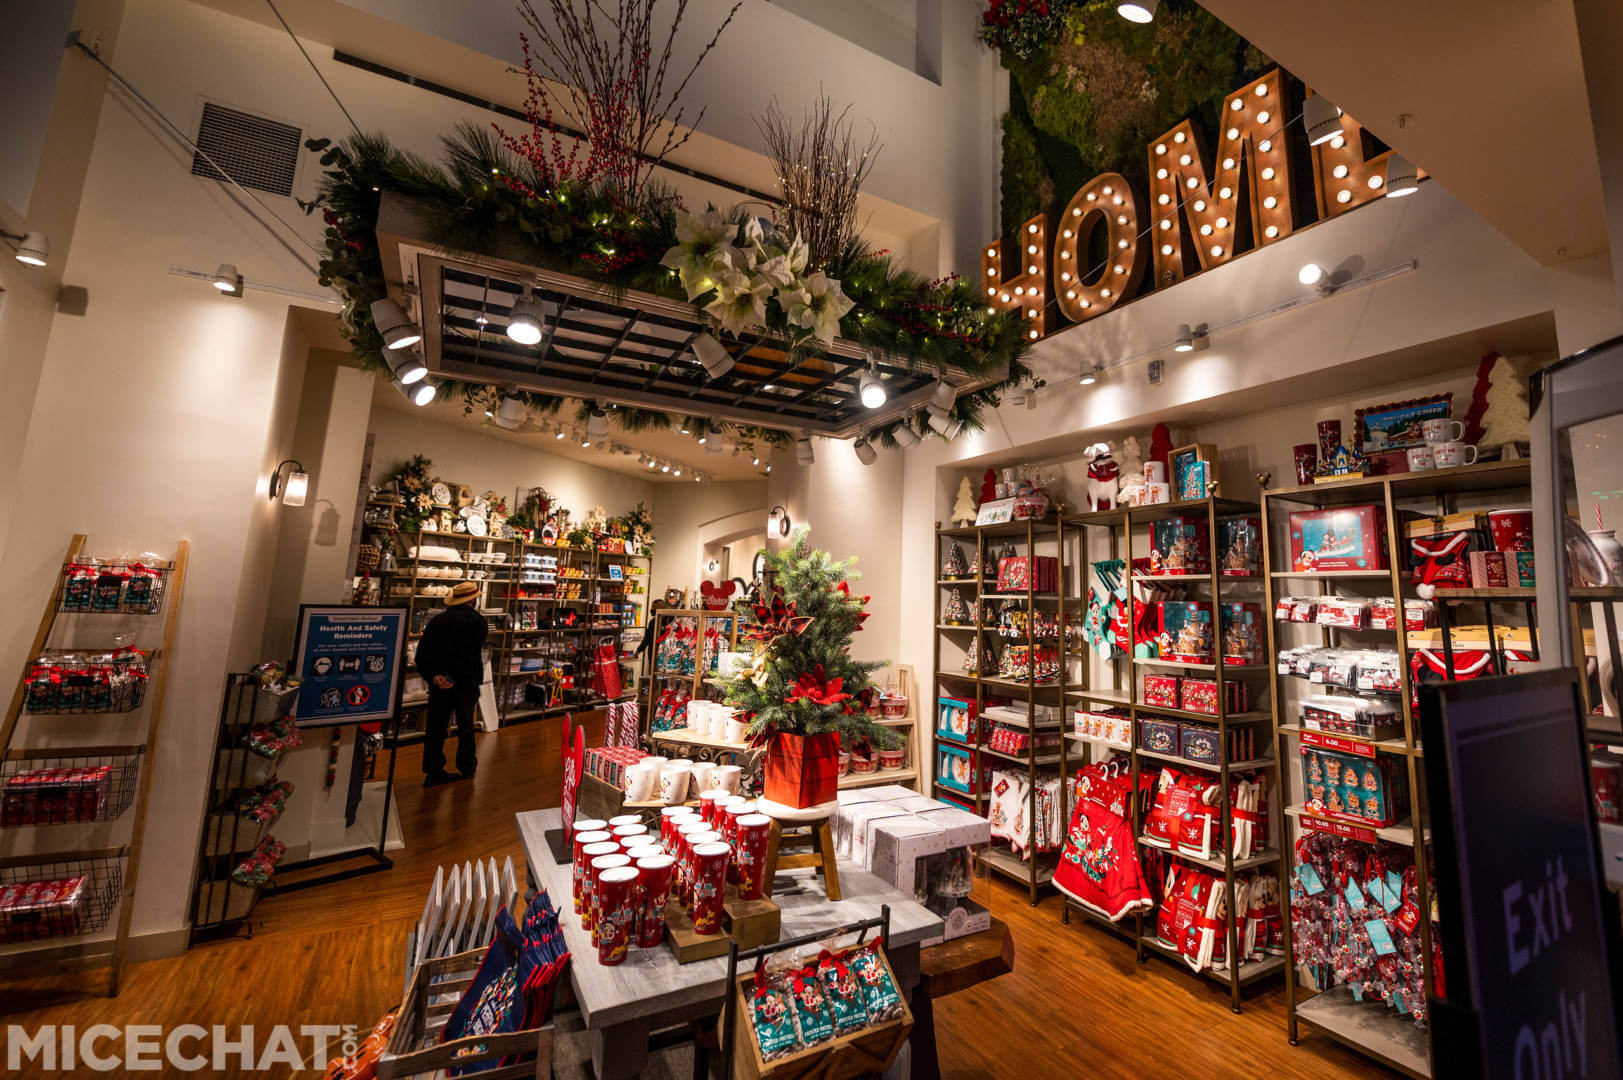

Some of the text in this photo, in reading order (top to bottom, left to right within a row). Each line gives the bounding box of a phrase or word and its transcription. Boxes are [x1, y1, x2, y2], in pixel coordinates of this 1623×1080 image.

[1325, 738, 1339, 746] 6.00
[1503, 855, 1573, 974] Exit
[1515, 989, 1588, 1080] Only
